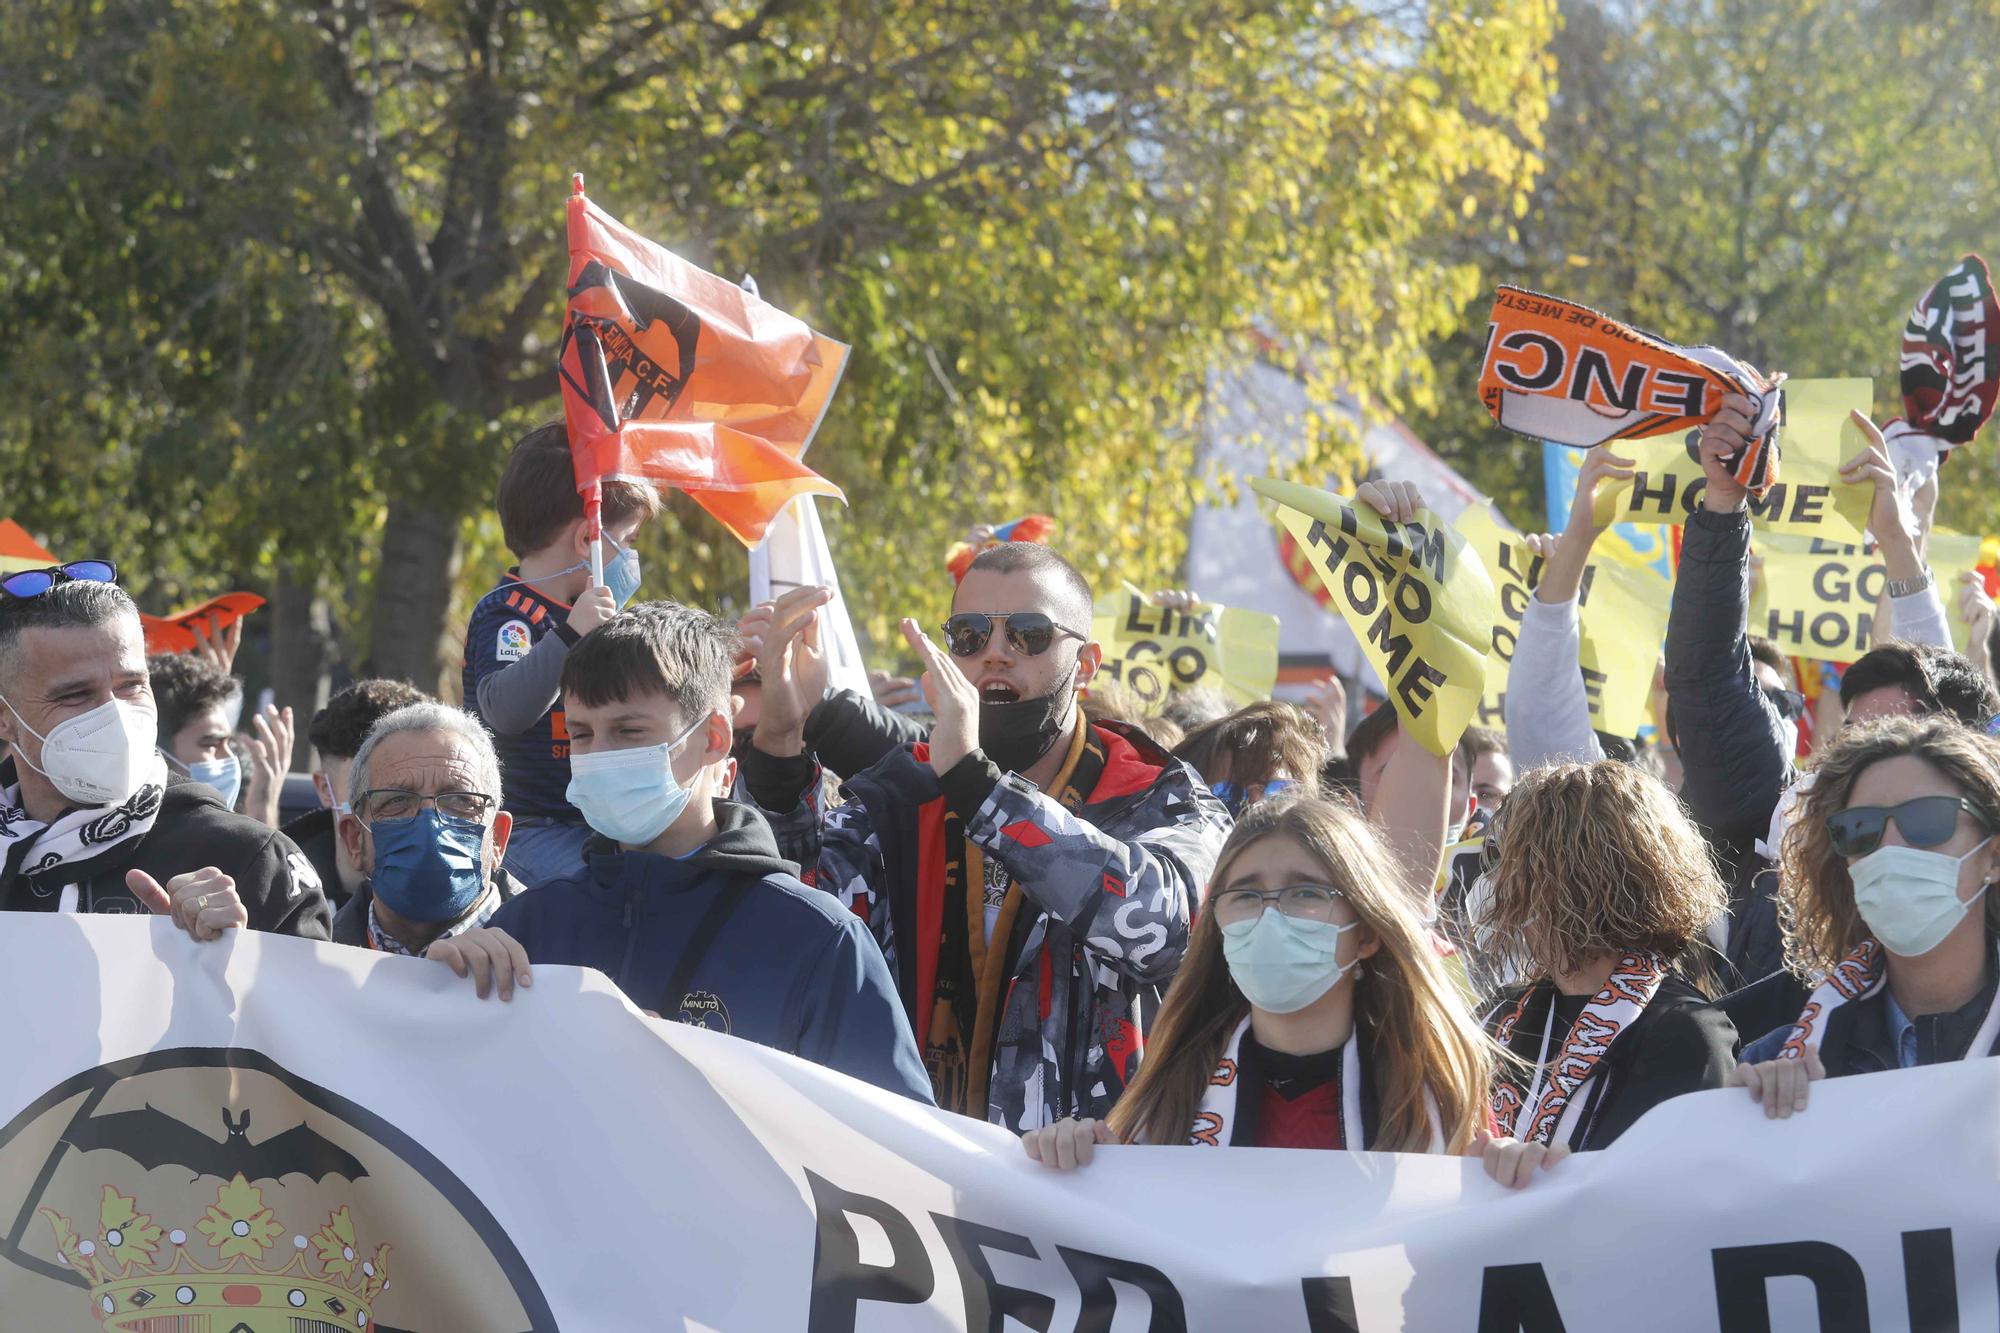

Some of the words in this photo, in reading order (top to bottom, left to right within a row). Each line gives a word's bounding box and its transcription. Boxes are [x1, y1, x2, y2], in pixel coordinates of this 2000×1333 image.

[1566, 310, 1598, 329] DE
[1306, 518, 1448, 720] HOME
[683, 1000, 718, 1010] MINUTO
